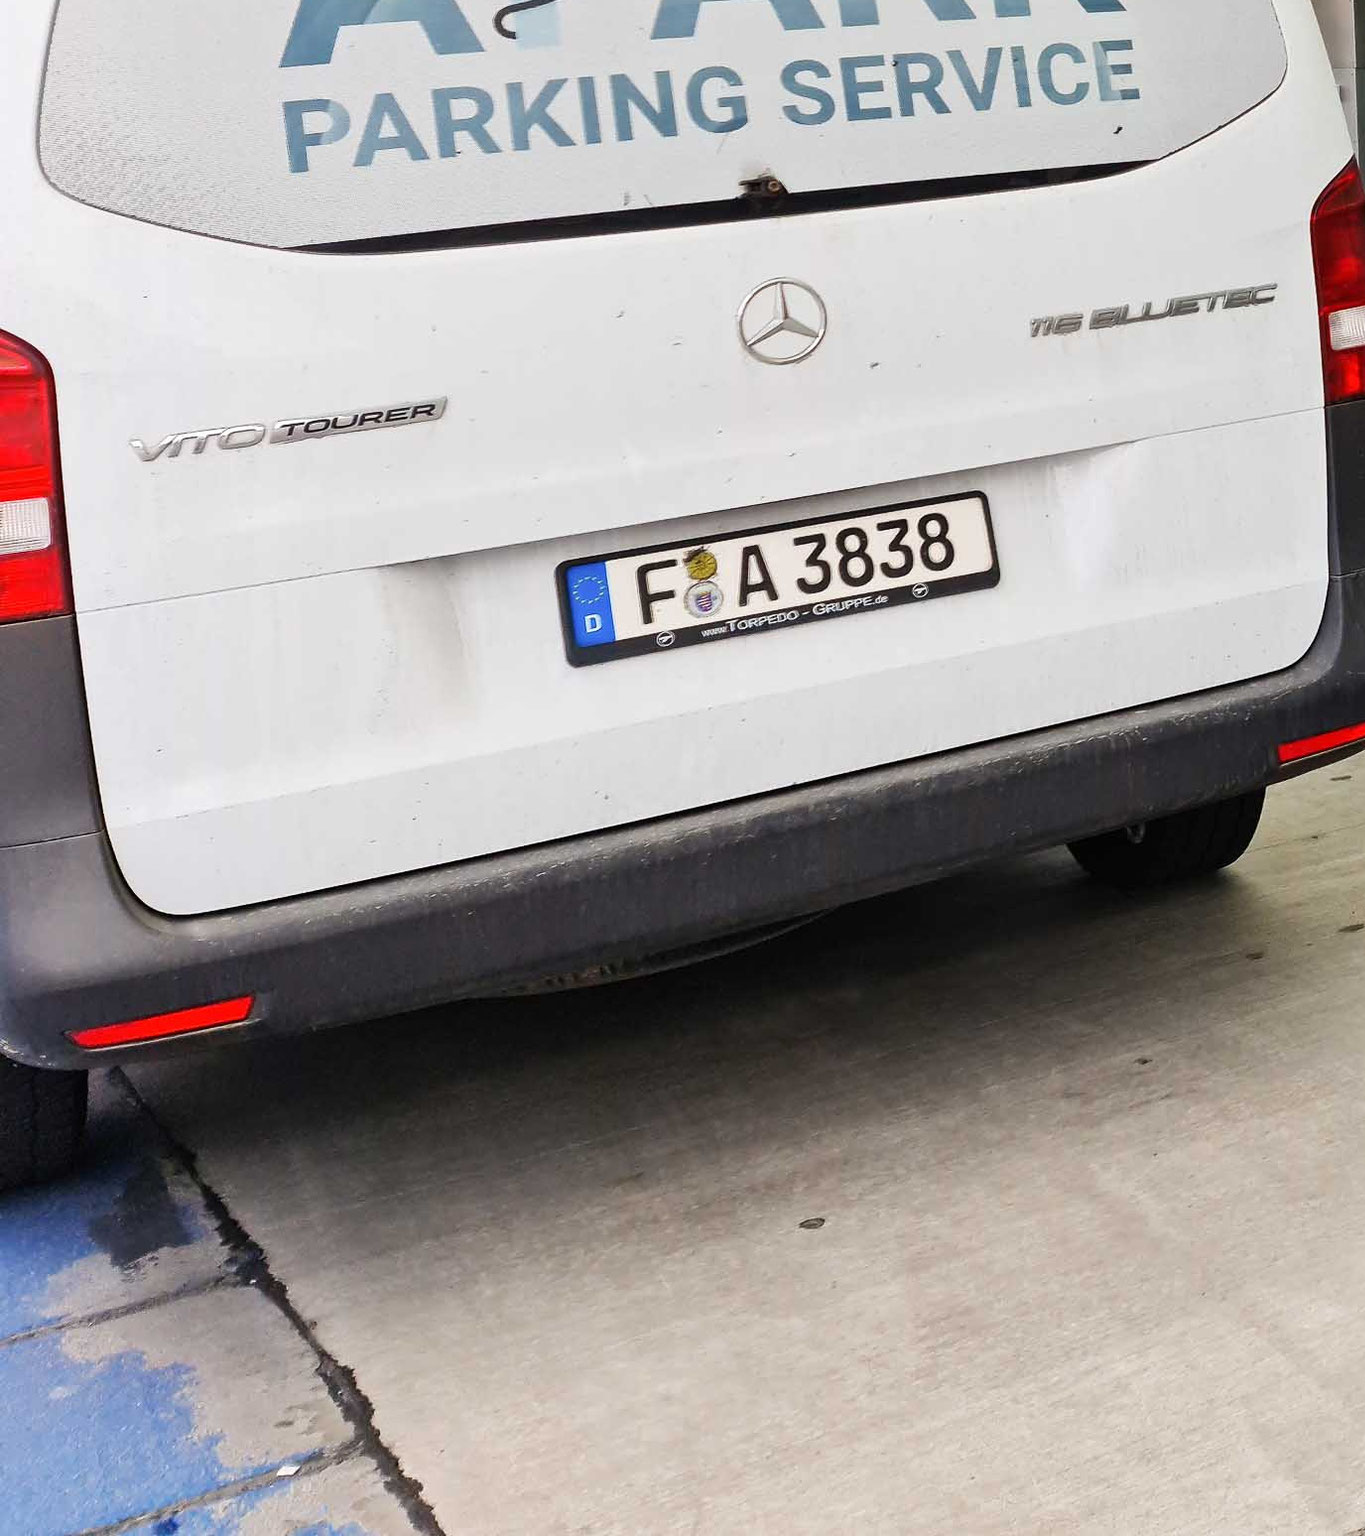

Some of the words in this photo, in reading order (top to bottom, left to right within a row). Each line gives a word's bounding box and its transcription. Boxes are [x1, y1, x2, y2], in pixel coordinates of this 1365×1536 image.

[283, 65, 748, 174] PARKING
[782, 38, 1141, 128] SERVICE
[1029, 313, 1084, 338] 116
[1088, 282, 1278, 330] BLUETEC
[128, 422, 266, 462] VITO
[279, 403, 437, 437] TOURER
[636, 558, 679, 625] F
[738, 544, 779, 608] A
[793, 512, 956, 596] 3838
[584, 613, 602, 635] D
